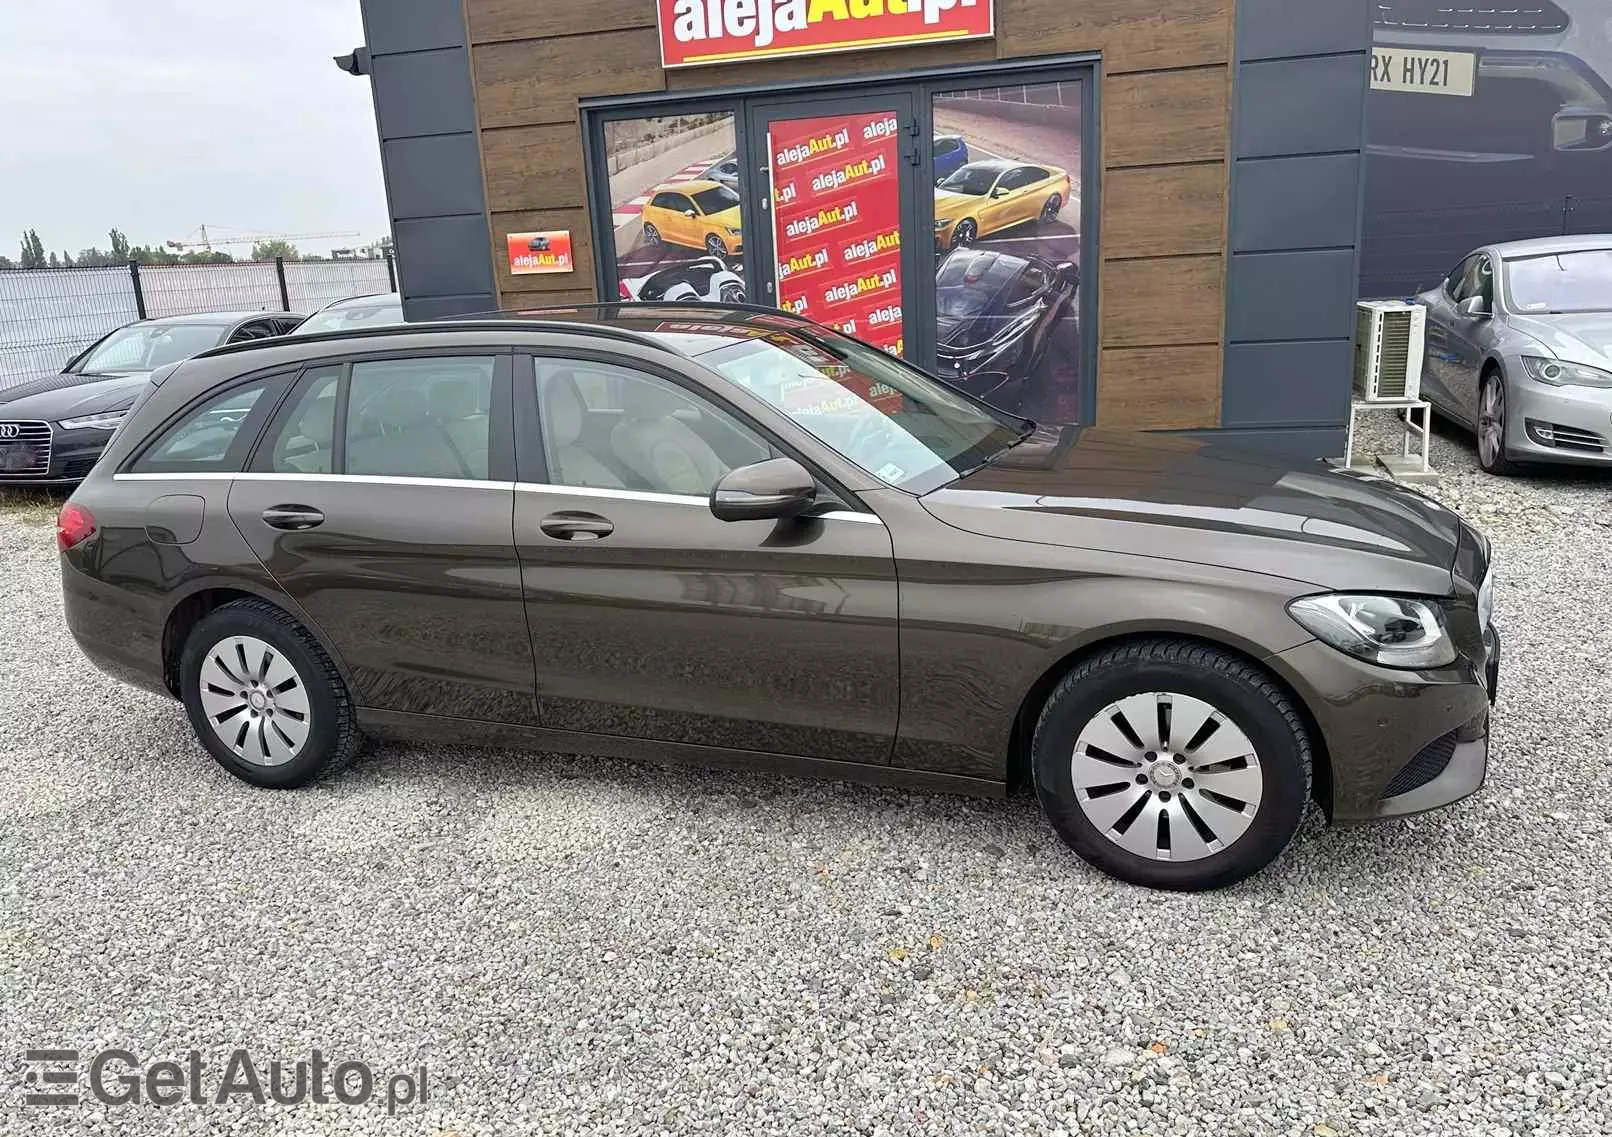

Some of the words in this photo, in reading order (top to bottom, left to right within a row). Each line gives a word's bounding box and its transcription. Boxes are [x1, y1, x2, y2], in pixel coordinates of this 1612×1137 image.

[673, 0, 976, 47] aleja.
[1402, 56, 1449, 87] HY21
[863, 118, 898, 139] aleja
[776, 128, 850, 166] alejaAut.pl
[812, 155, 886, 192] alejaAut.pl
[785, 201, 858, 237] alejaAut.pl
[513, 252, 569, 268] alejaAut.pl
[825, 269, 897, 303] alejaAut.pl
[868, 305, 903, 325] aleja
